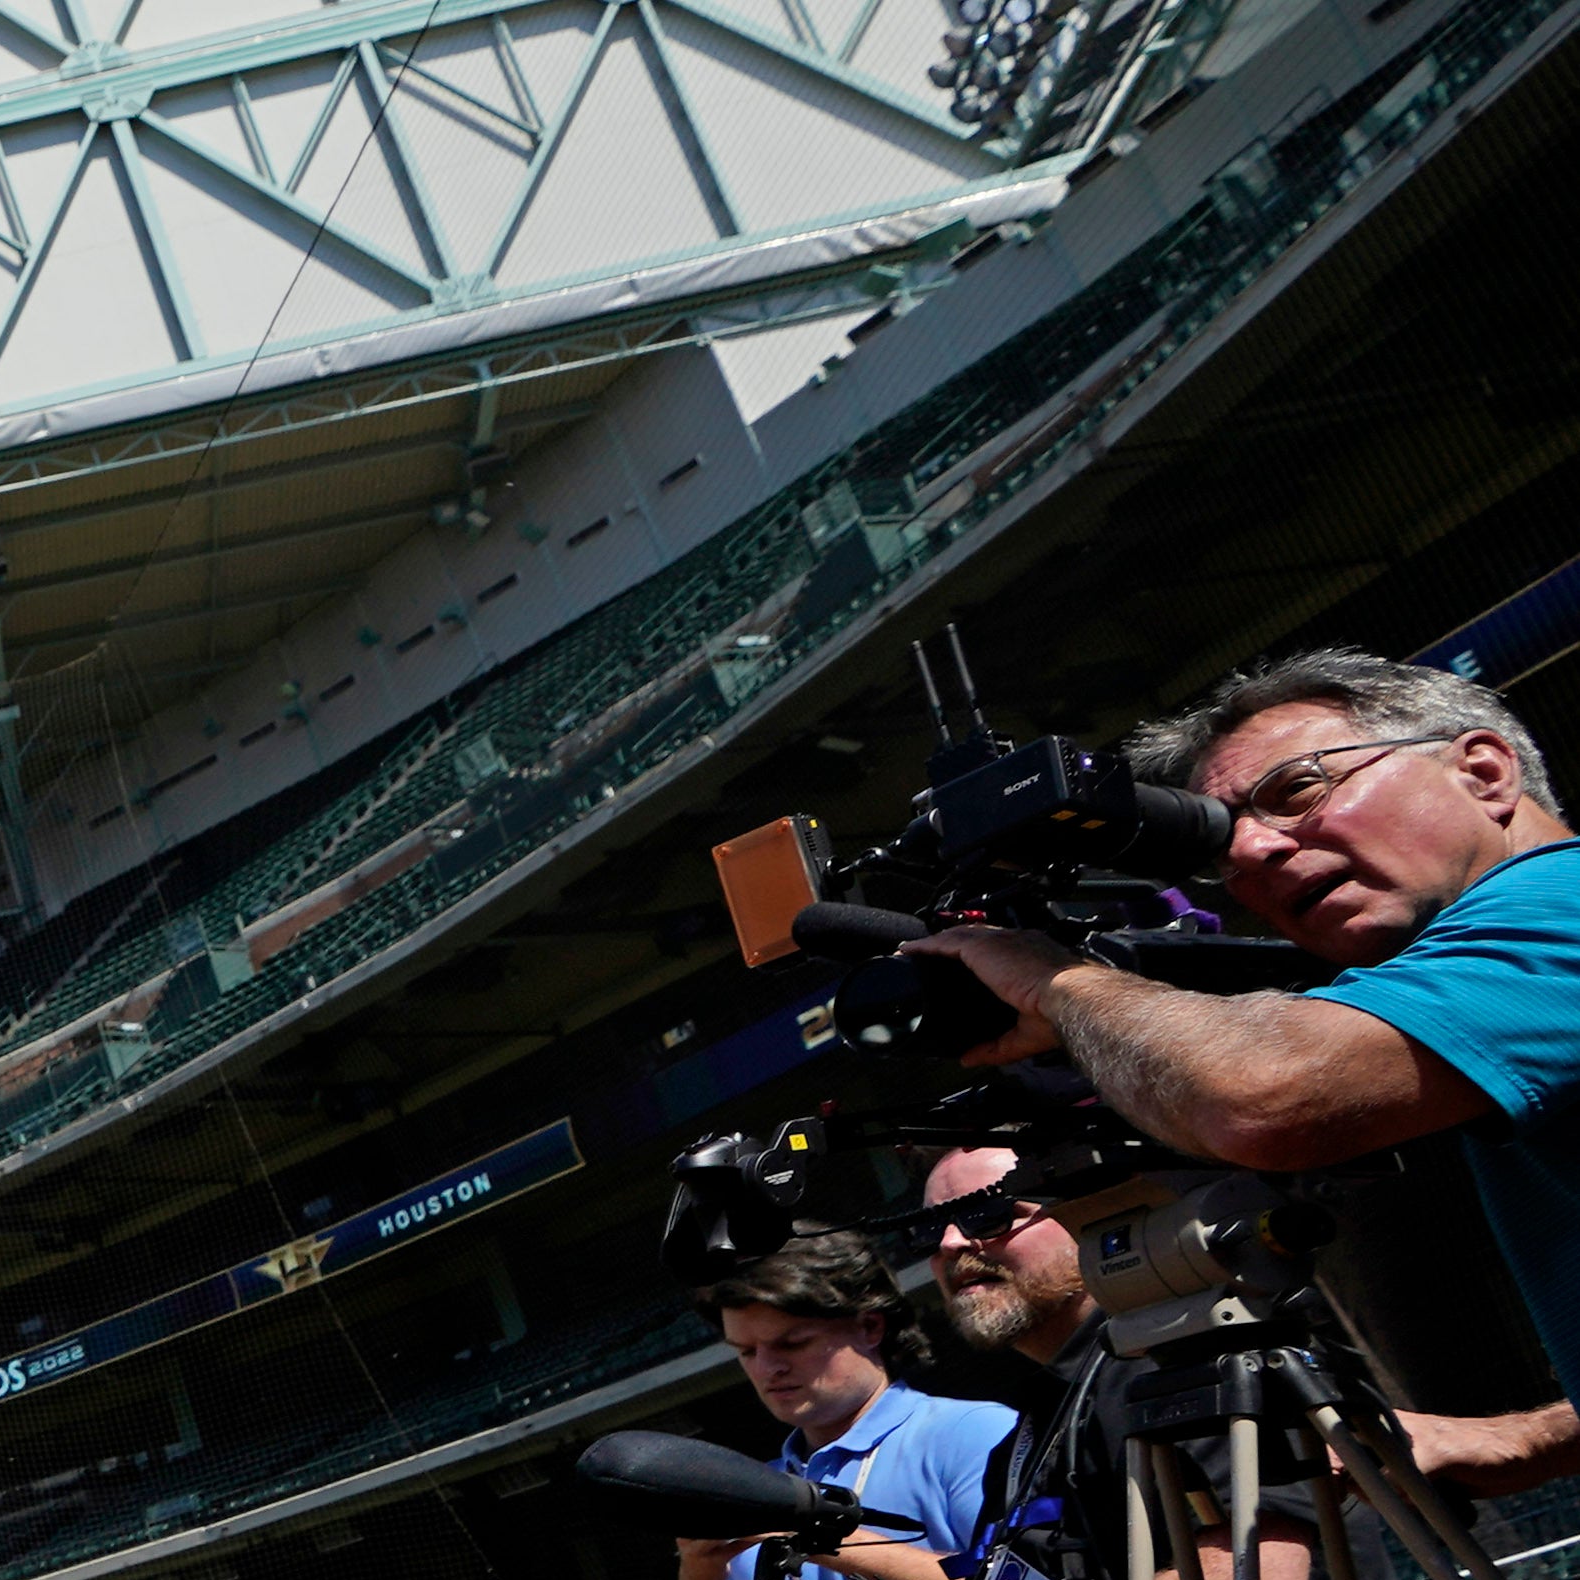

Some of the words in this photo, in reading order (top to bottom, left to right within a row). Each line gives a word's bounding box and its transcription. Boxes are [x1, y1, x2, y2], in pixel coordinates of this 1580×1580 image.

[1003, 772, 1042, 796] SONY
[376, 1171, 492, 1240] HOUSTON
[1099, 1255, 1142, 1276] Vinten
[27, 1344, 87, 1379] 2022
